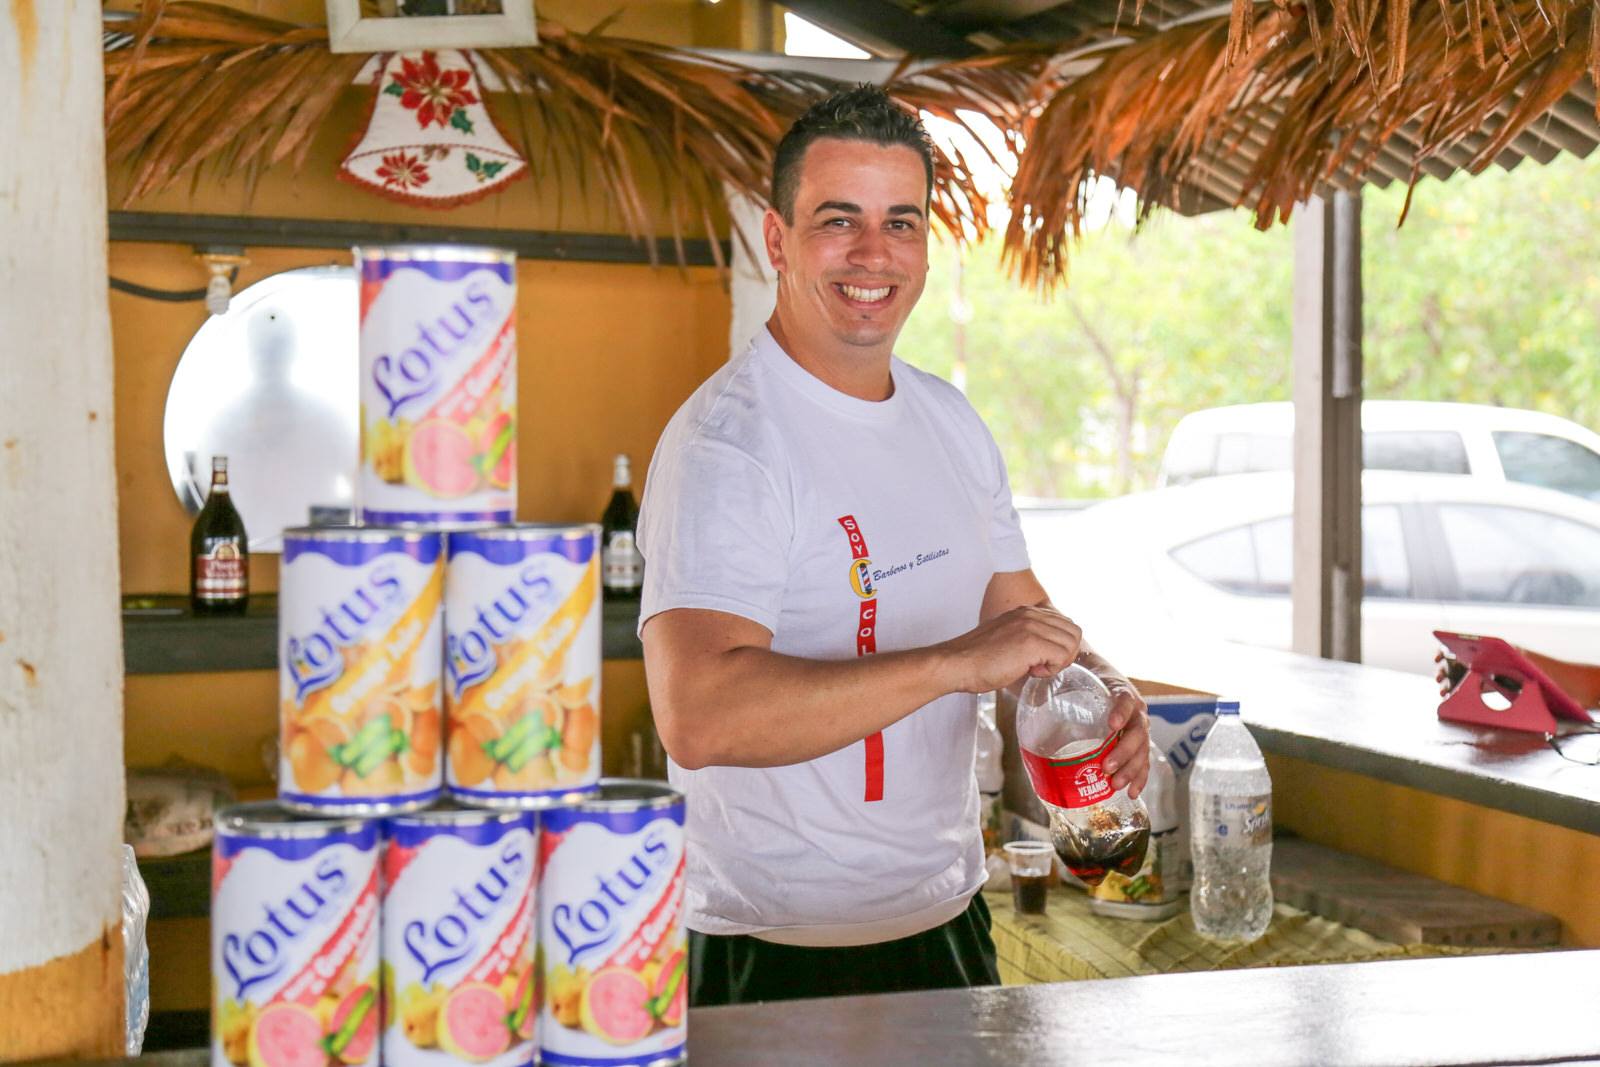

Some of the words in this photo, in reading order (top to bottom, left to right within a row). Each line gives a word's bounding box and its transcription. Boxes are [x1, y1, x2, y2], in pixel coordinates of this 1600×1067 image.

[372, 279, 493, 419] Lotus
[844, 519, 863, 555] SOY
[873, 564, 907, 582] Barberos
[909, 561, 914, 571] y
[916, 548, 950, 567] Estilistas
[286, 562, 402, 703] Lotus
[446, 561, 551, 699] Lotus
[222, 855, 346, 999] Lotus
[404, 841, 522, 983] Lotus
[552, 832, 667, 965] Lotus
